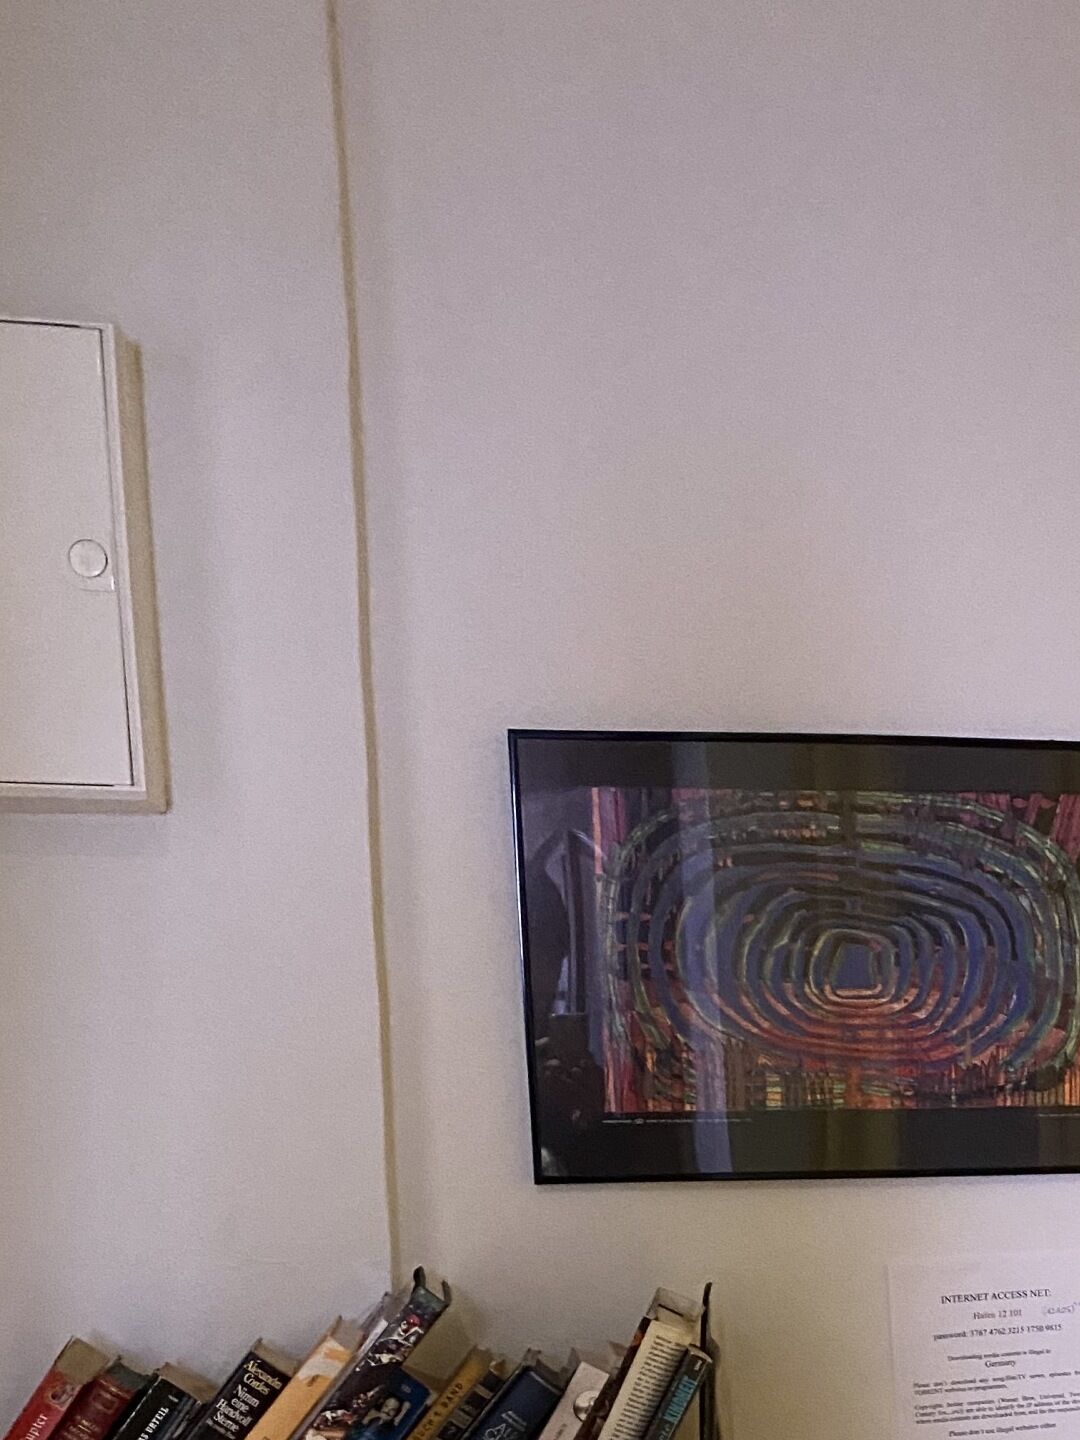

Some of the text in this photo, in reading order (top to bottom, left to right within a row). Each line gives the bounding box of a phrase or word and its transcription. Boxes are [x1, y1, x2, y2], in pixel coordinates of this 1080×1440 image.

[940, 1292, 989, 1304] INTERNET
[991, 1290, 1028, 1300] ACCESS
[233, 1384, 260, 1407] Nimm
[439, 1380, 466, 1409] BAND
[213, 1411, 239, 1432] Sterne
